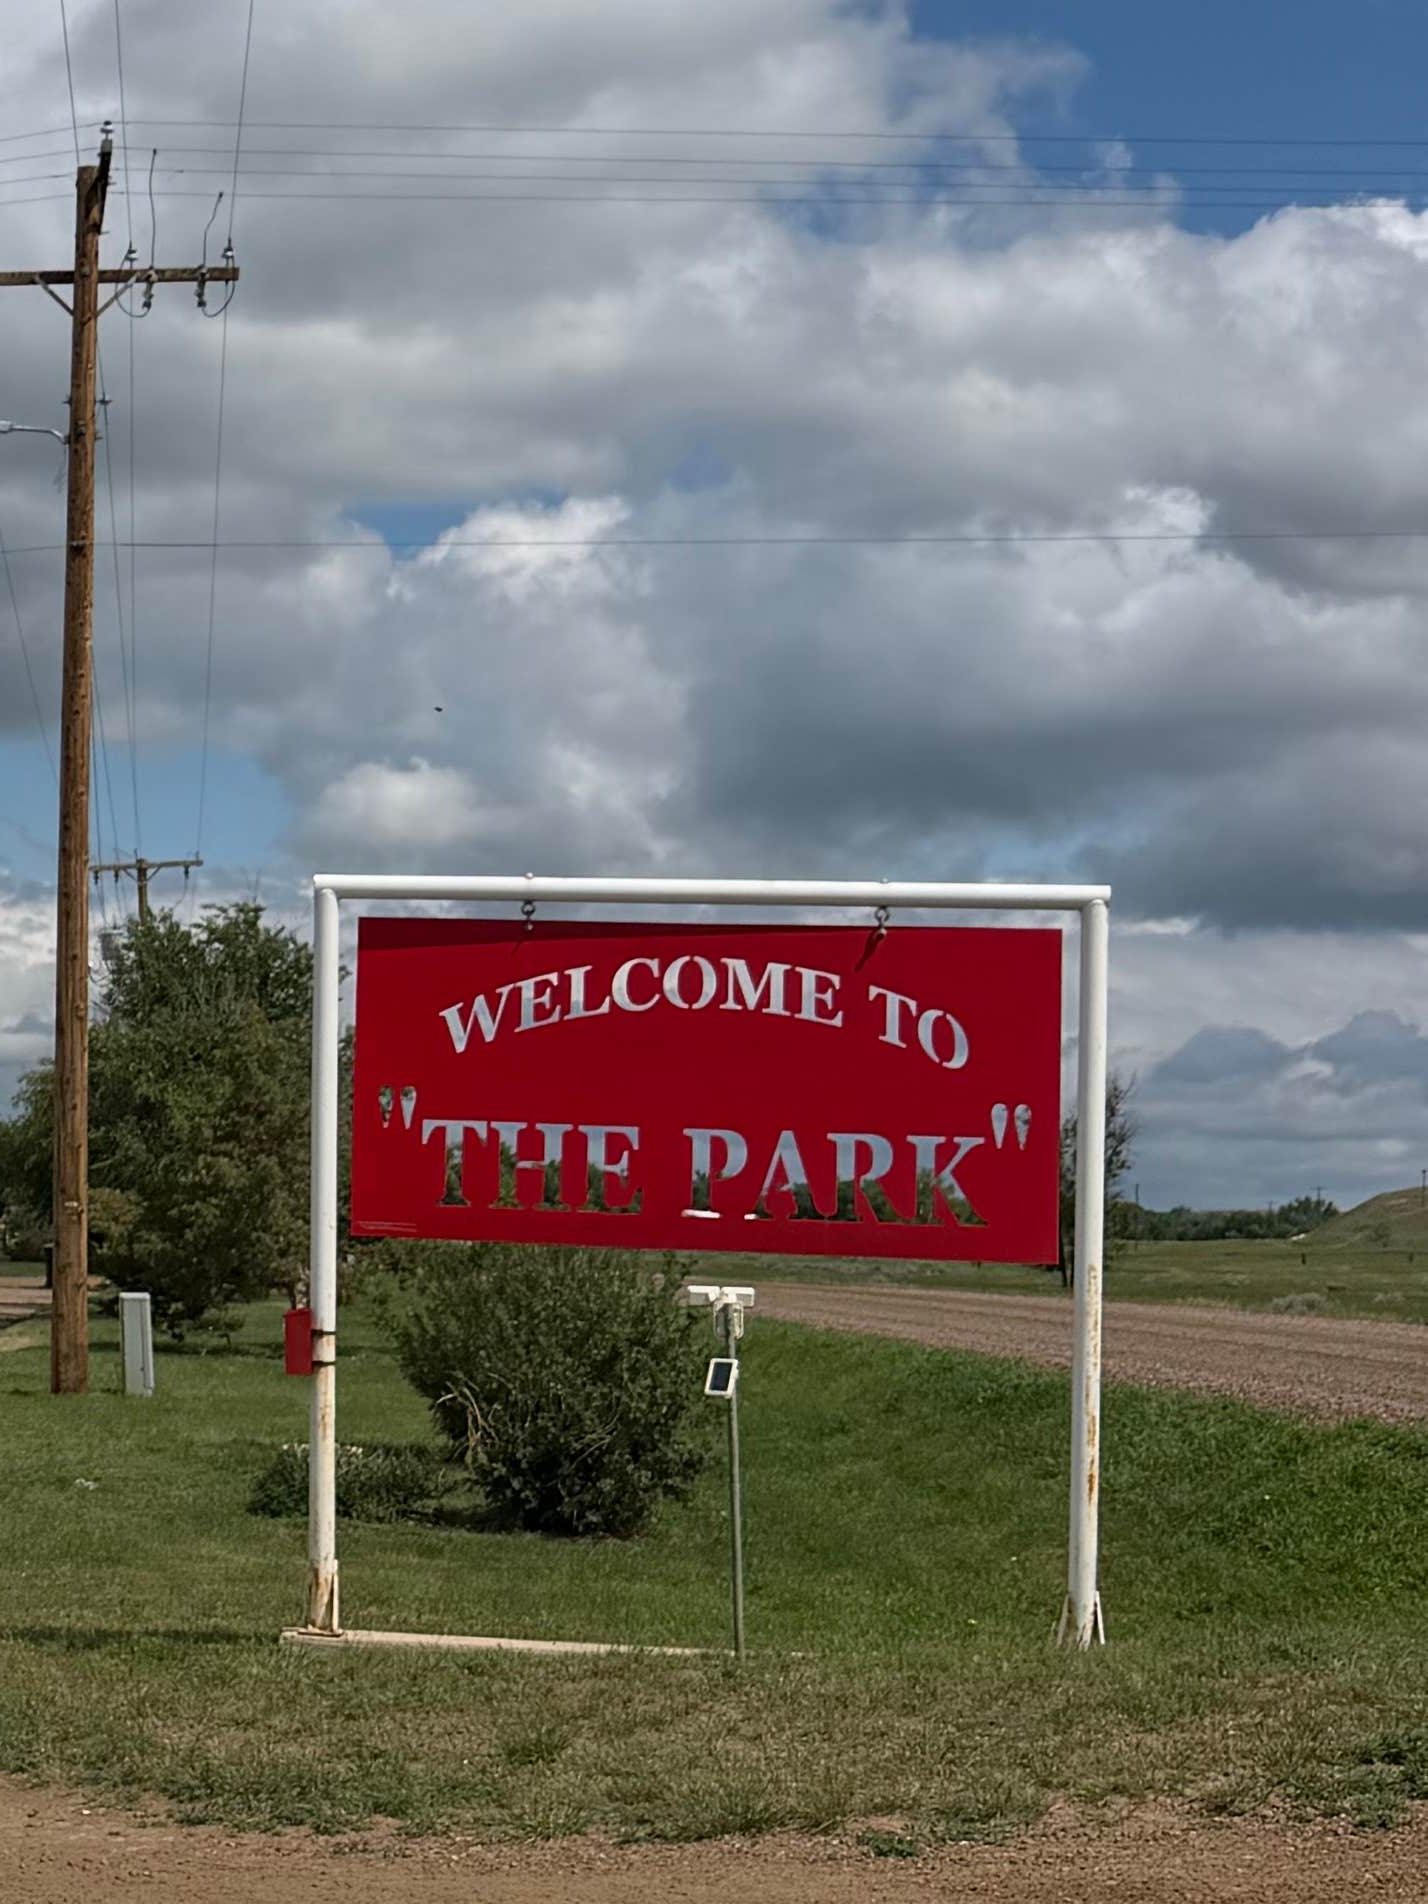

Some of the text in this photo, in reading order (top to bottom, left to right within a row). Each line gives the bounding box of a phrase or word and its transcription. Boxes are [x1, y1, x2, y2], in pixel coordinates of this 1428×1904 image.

[438, 954, 971, 1070] WELCOME TO
[376, 1083, 1033, 1228] "THE PARK"
